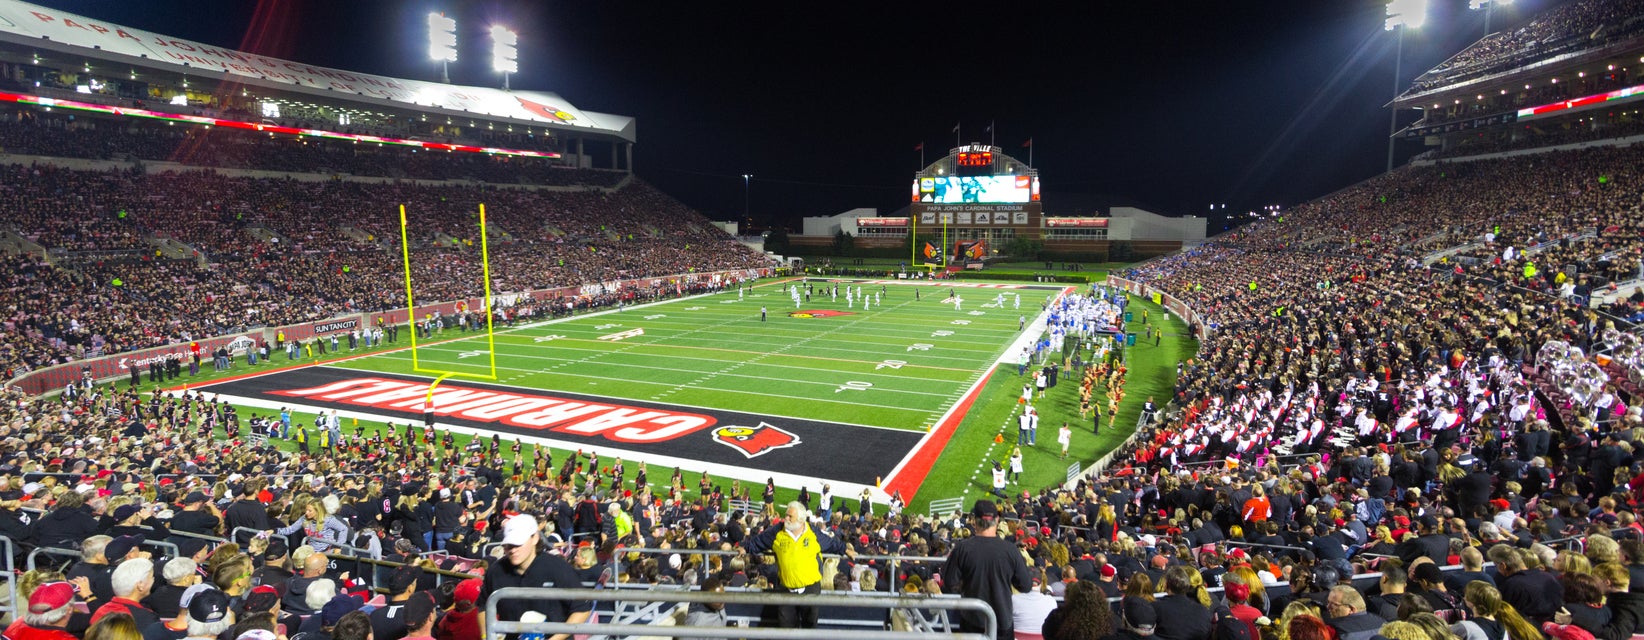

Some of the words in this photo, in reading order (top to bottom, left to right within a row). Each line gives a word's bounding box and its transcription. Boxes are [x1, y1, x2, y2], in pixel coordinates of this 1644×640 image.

[30, 11, 141, 42] PAPA
[315, 325, 329, 333] SUN
[329, 323, 343, 331] TAN
[343, 320, 357, 329] CITY
[838, 381, 873, 392] 10
[280, 378, 709, 441] CARDINALS
